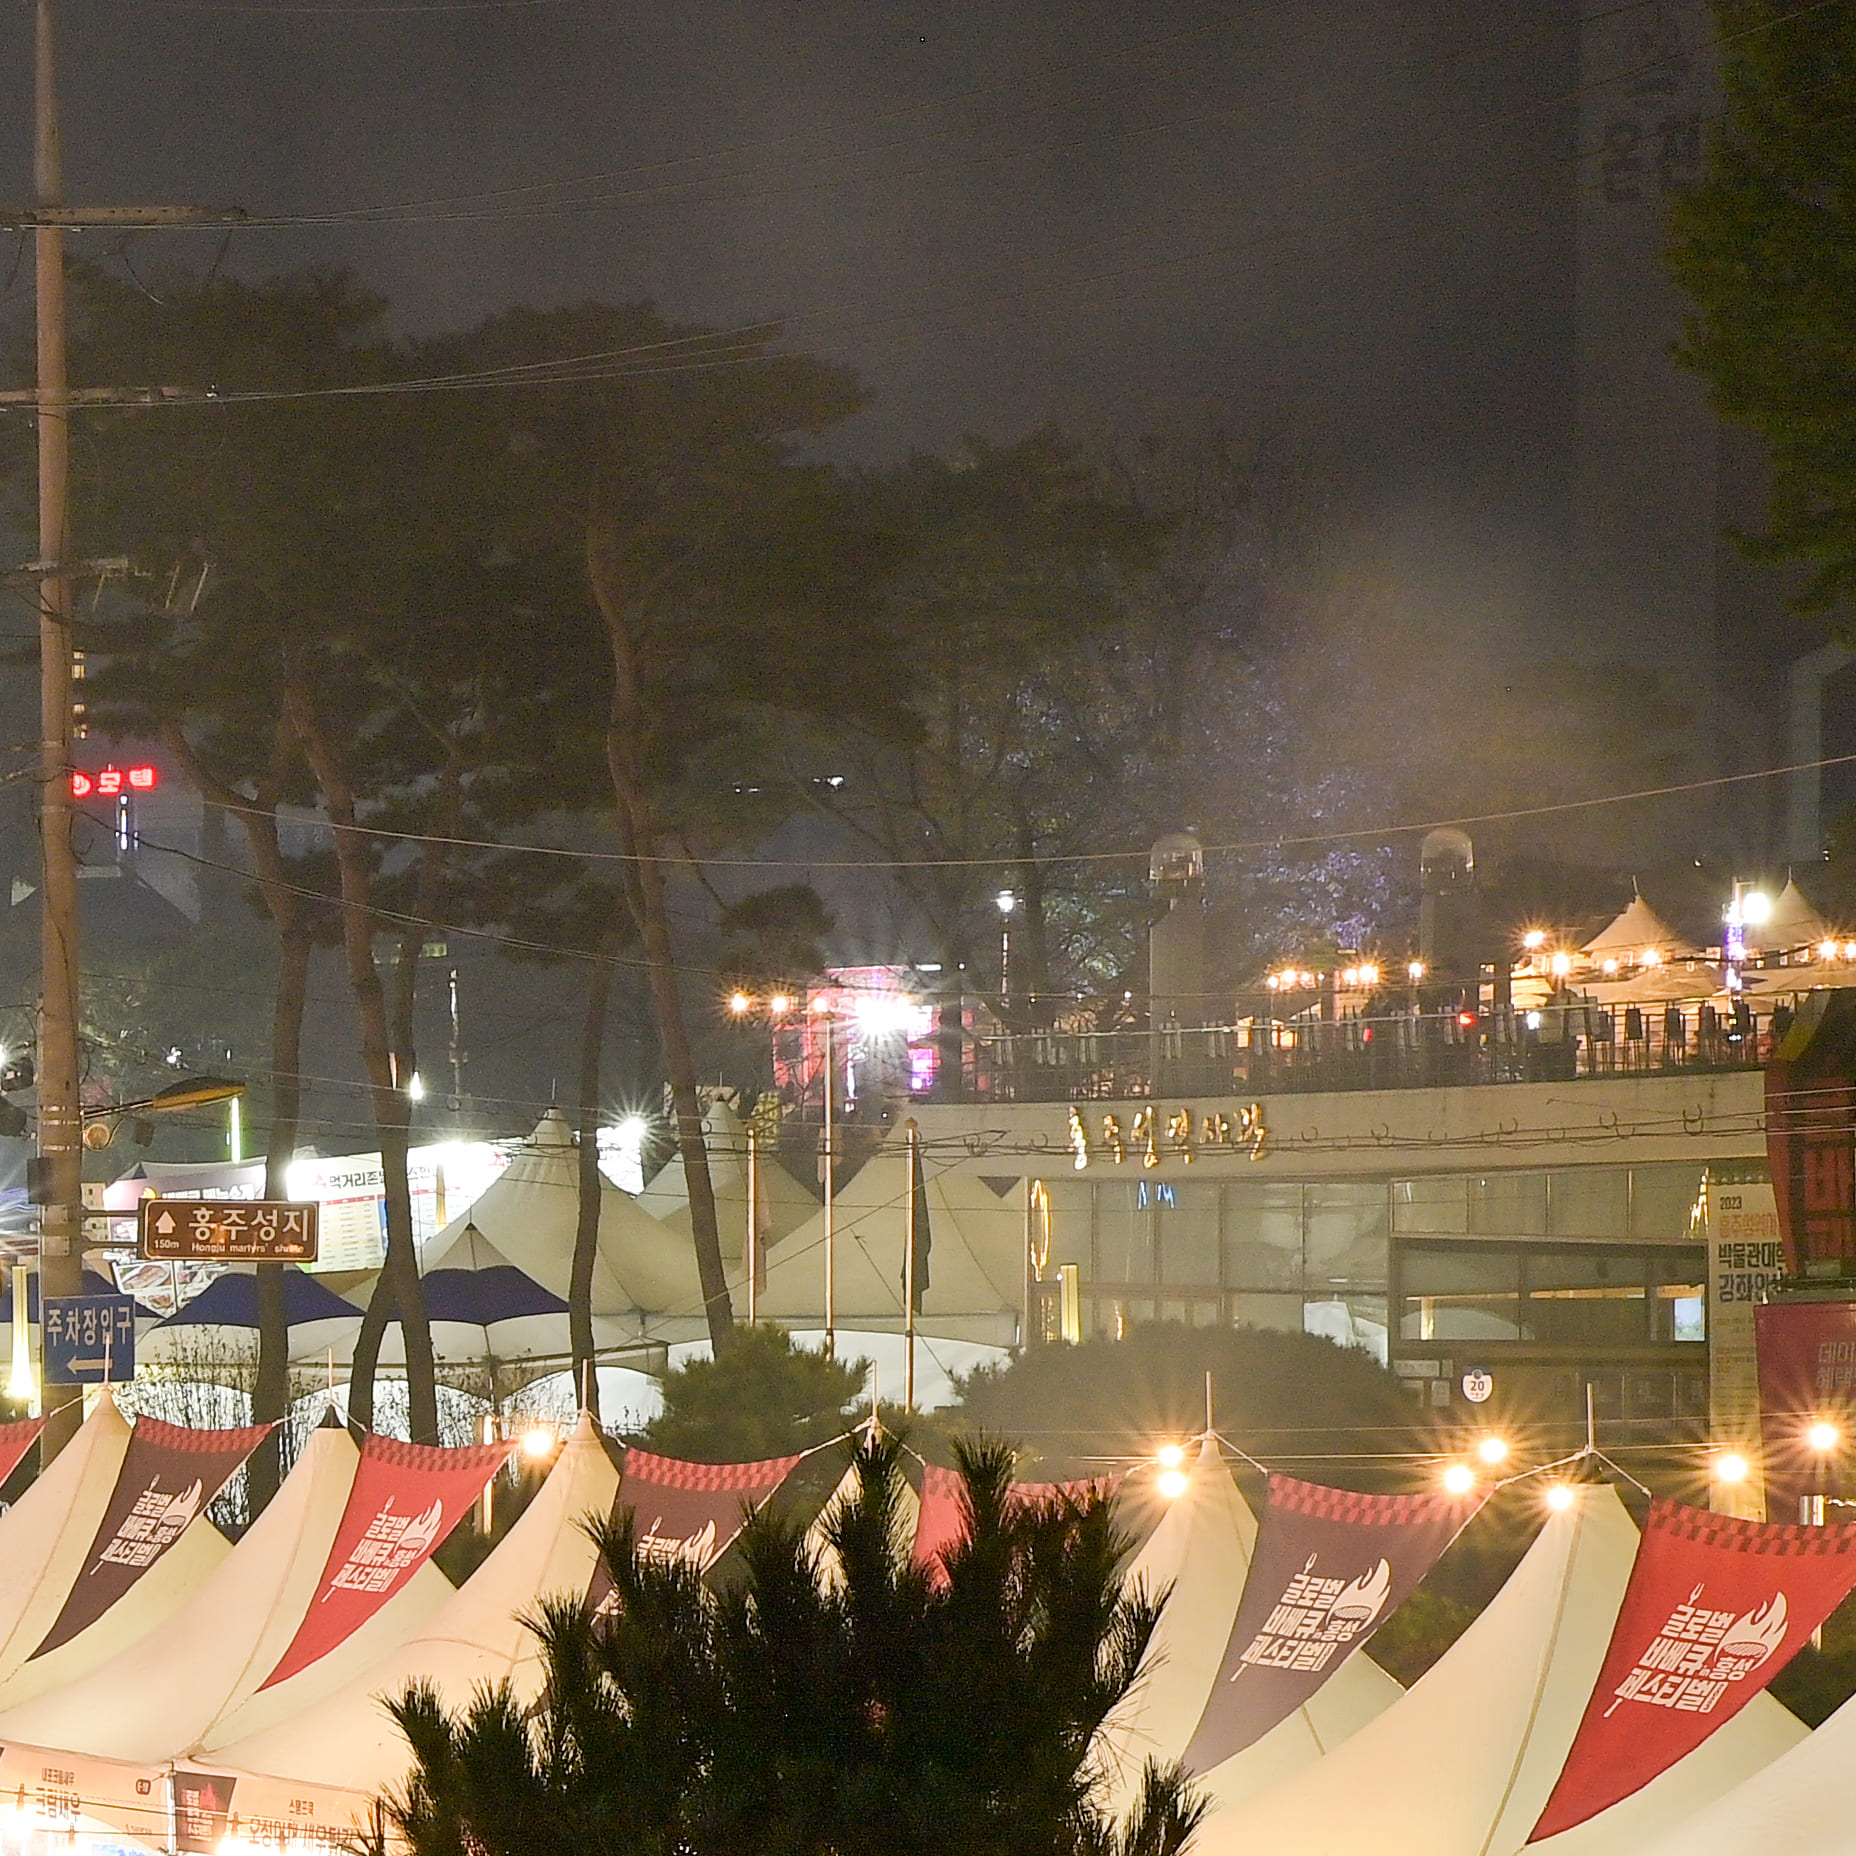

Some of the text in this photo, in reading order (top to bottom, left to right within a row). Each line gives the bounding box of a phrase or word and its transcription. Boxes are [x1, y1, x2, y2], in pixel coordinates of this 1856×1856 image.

[98, 767, 154, 793] 모텔
[1720, 1197, 1742, 1210] 2023
[189, 1207, 308, 1241] 홍주성지
[154, 1240, 180, 1249] 150m
[191, 1242, 226, 1254] Hongju
[47, 1306, 132, 1347] 주차장입구
[1470, 1381, 1485, 1391] 20
[131, 1490, 173, 1517] 글로벌
[117, 1514, 158, 1541] 바베큐
[365, 1513, 411, 1542] 글로벌
[99, 1538, 154, 1567] 페스티벌
[349, 1538, 395, 1566] 바베큐
[330, 1563, 391, 1592] 페스티벌
[1280, 1573, 1346, 1609] 글로벌
[1262, 1604, 1327, 1639] 바베큐
[1320, 1620, 1361, 1642] 홍성
[1661, 1604, 1736, 1643] 글로벌
[1240, 1635, 1327, 1671] 페스티벌
[1638, 1637, 1714, 1676] 바베큐
[1709, 1657, 1755, 1681] 홍성
[1614, 1668, 1715, 1712] 페스티벌
